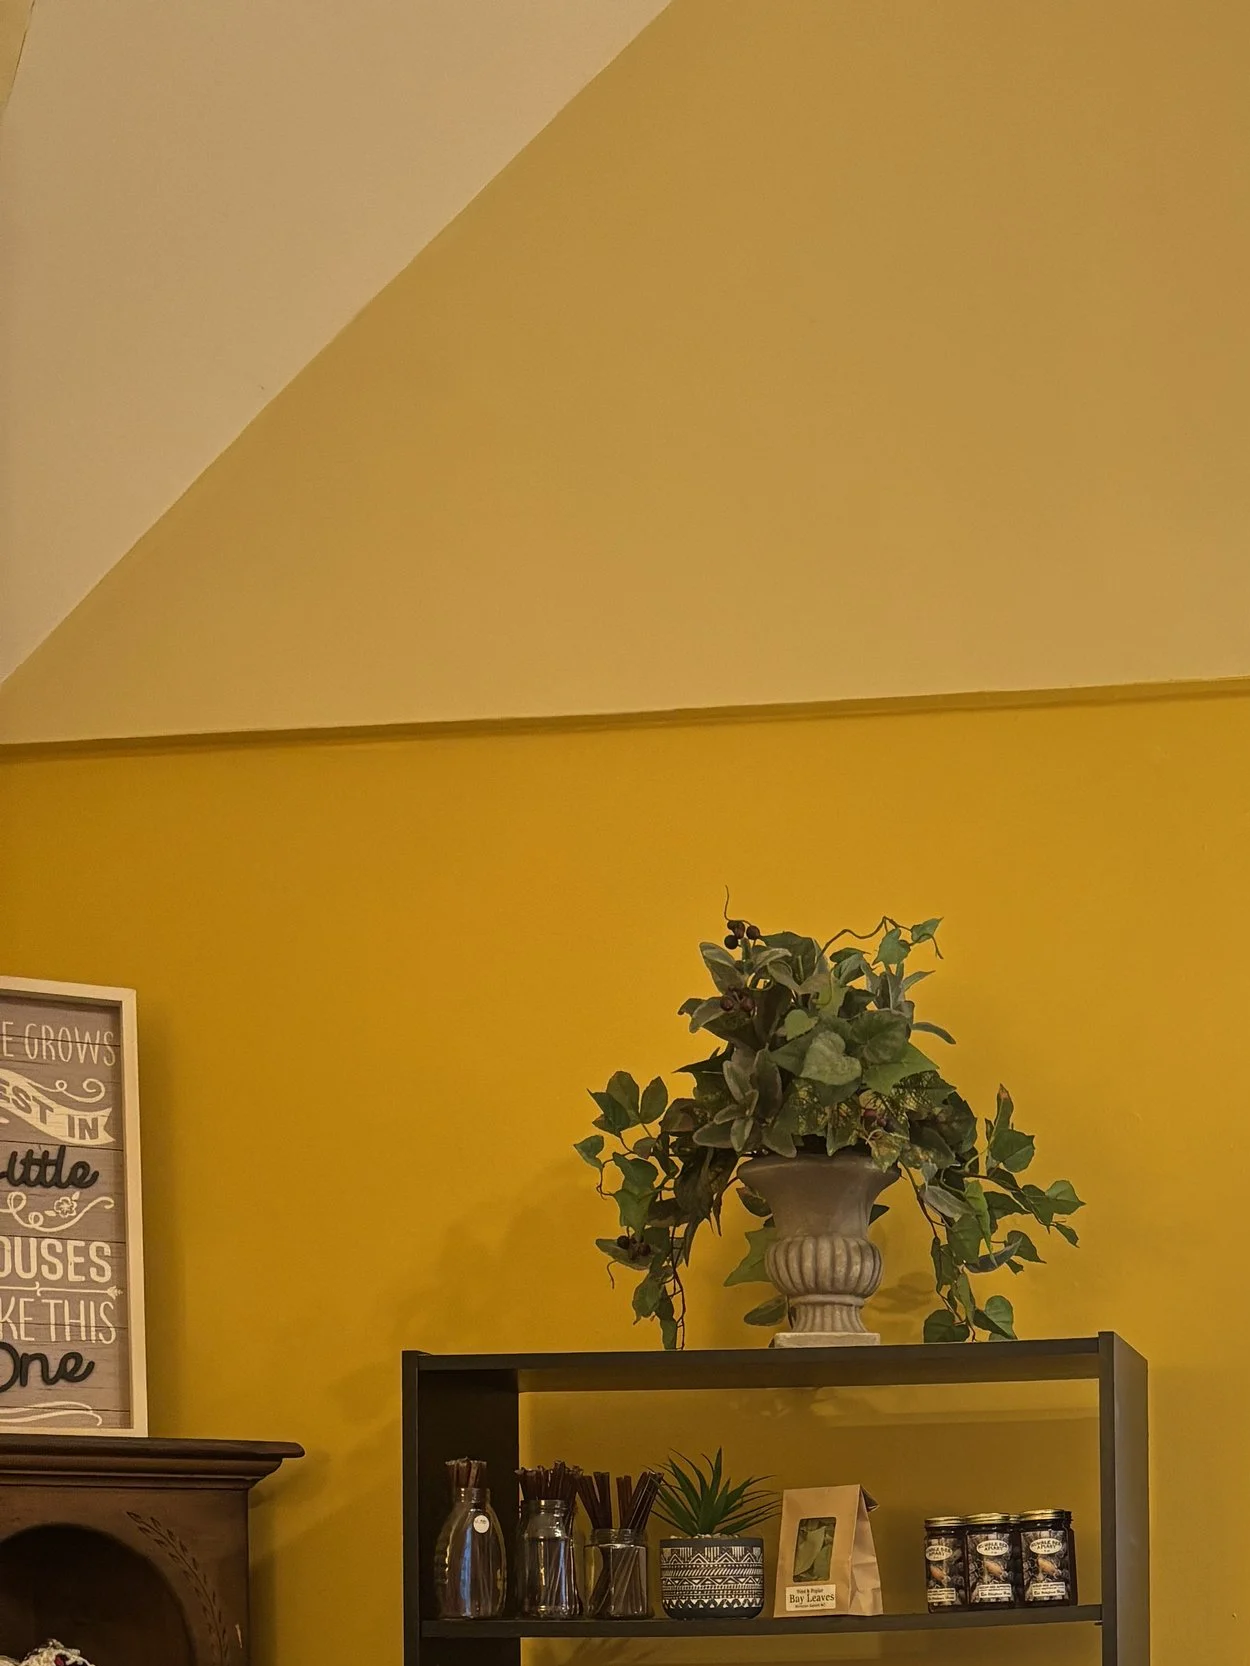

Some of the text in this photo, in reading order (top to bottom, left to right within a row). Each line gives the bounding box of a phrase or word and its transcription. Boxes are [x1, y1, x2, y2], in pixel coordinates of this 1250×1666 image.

[25, 1022, 116, 1067] GROWS
[67, 1114, 99, 1140] IN
[0, 1144, 99, 1189] ittle
[41, 1298, 117, 1344] THIS
[789, 1593, 835, 1604] Bay Leaves
